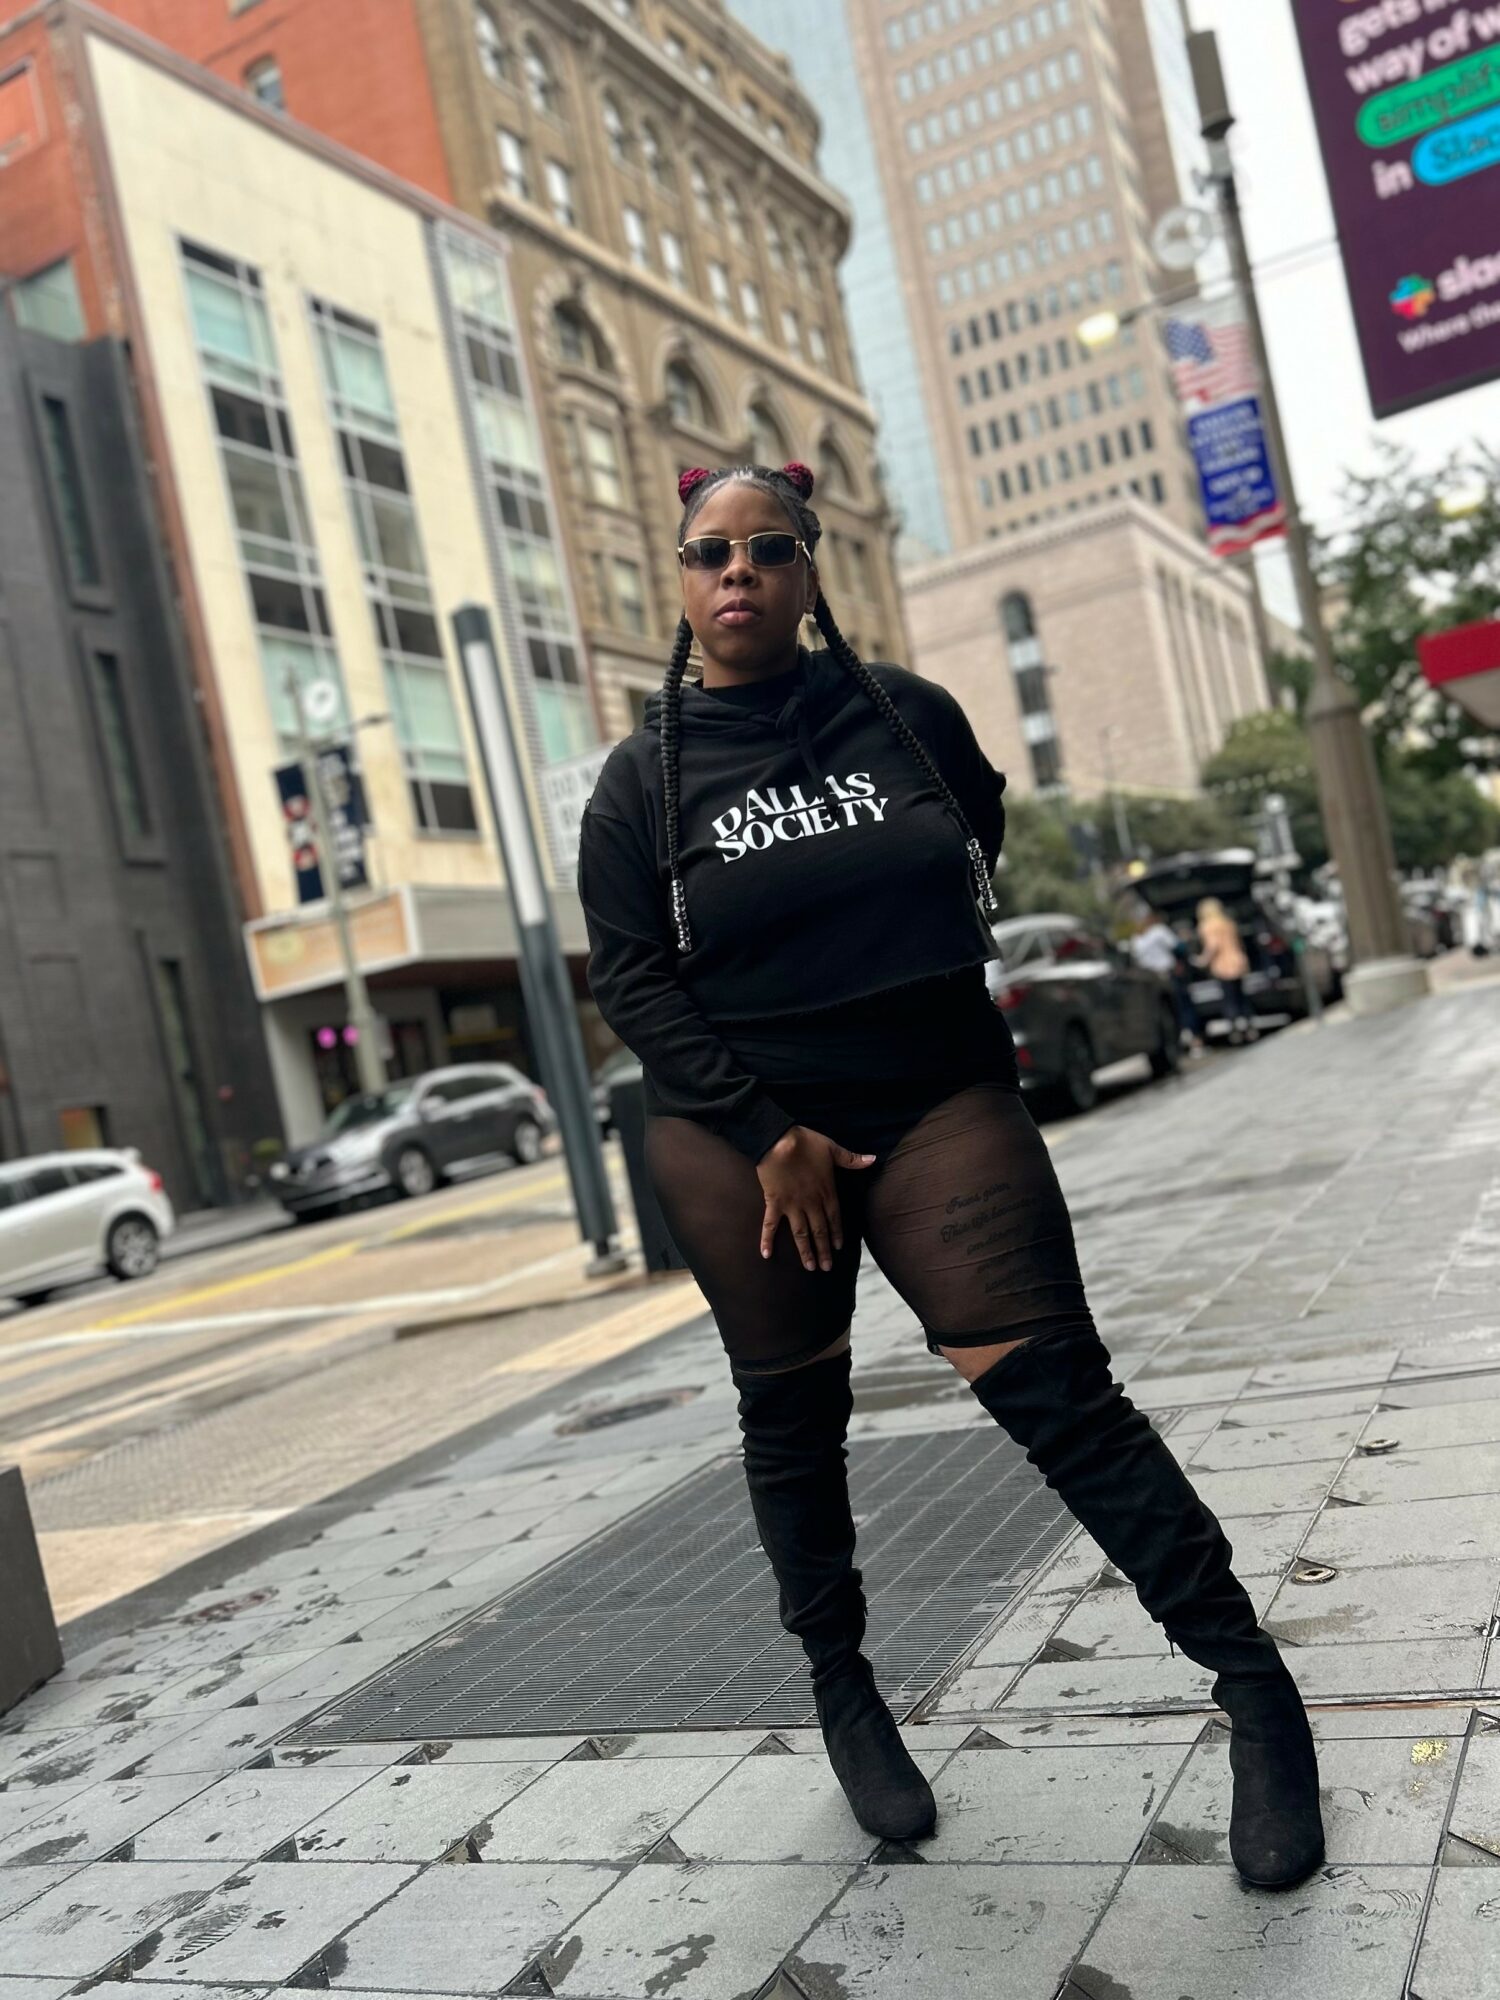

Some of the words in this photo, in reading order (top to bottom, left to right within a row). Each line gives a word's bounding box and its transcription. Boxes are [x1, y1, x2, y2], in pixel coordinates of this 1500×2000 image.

[1345, 37, 1425, 94] way
[1426, 8, 1470, 61] of
[1371, 159, 1414, 200] in
[1396, 313, 1471, 355] Where
[711, 772, 877, 841] DALLAS
[715, 797, 889, 864] SOCIETY
